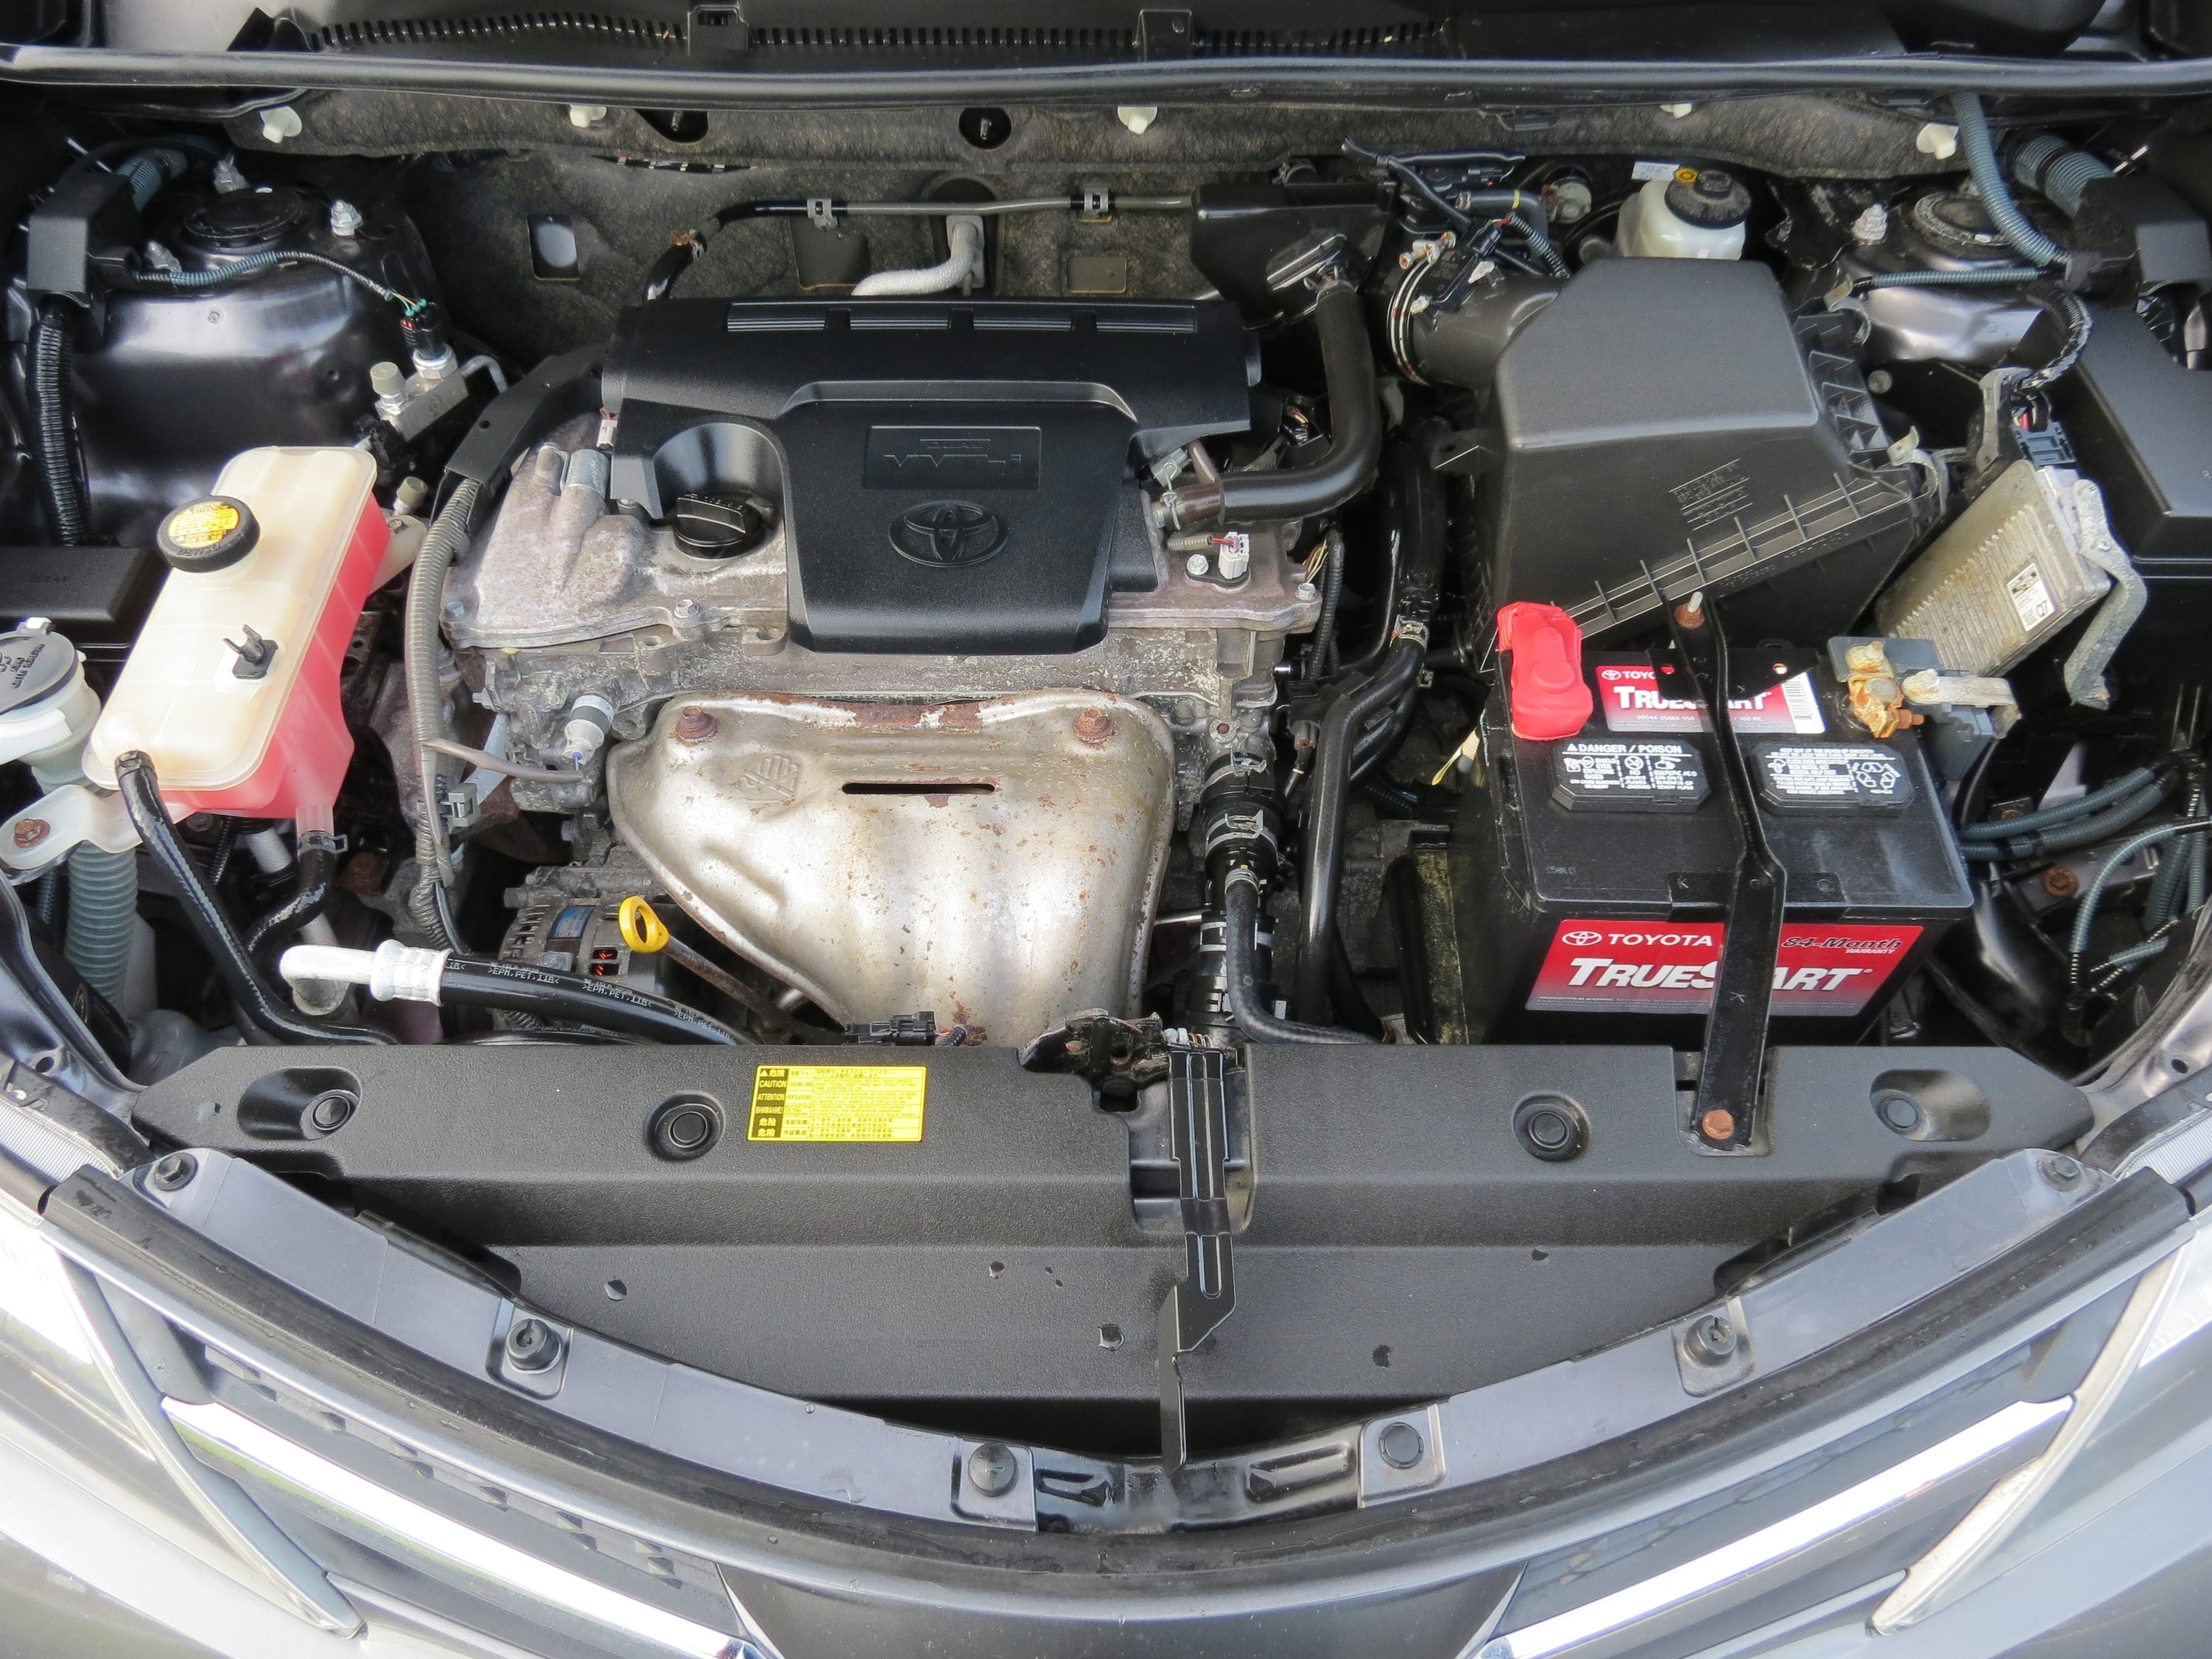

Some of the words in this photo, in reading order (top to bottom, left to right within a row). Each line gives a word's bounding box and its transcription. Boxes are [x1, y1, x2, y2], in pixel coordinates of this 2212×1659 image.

[1622, 671, 1656, 680] TOYO
[1578, 743, 1627, 753] DANGER
[1629, 744, 1636, 753] /
[1637, 744, 1683, 754] POISON
[1608, 933, 1713, 947] TOYOTA
[1781, 936, 1903, 950] 84-Month
[759, 1079, 786, 1088] CAUTION
[757, 1093, 785, 1101] ATTENTION
